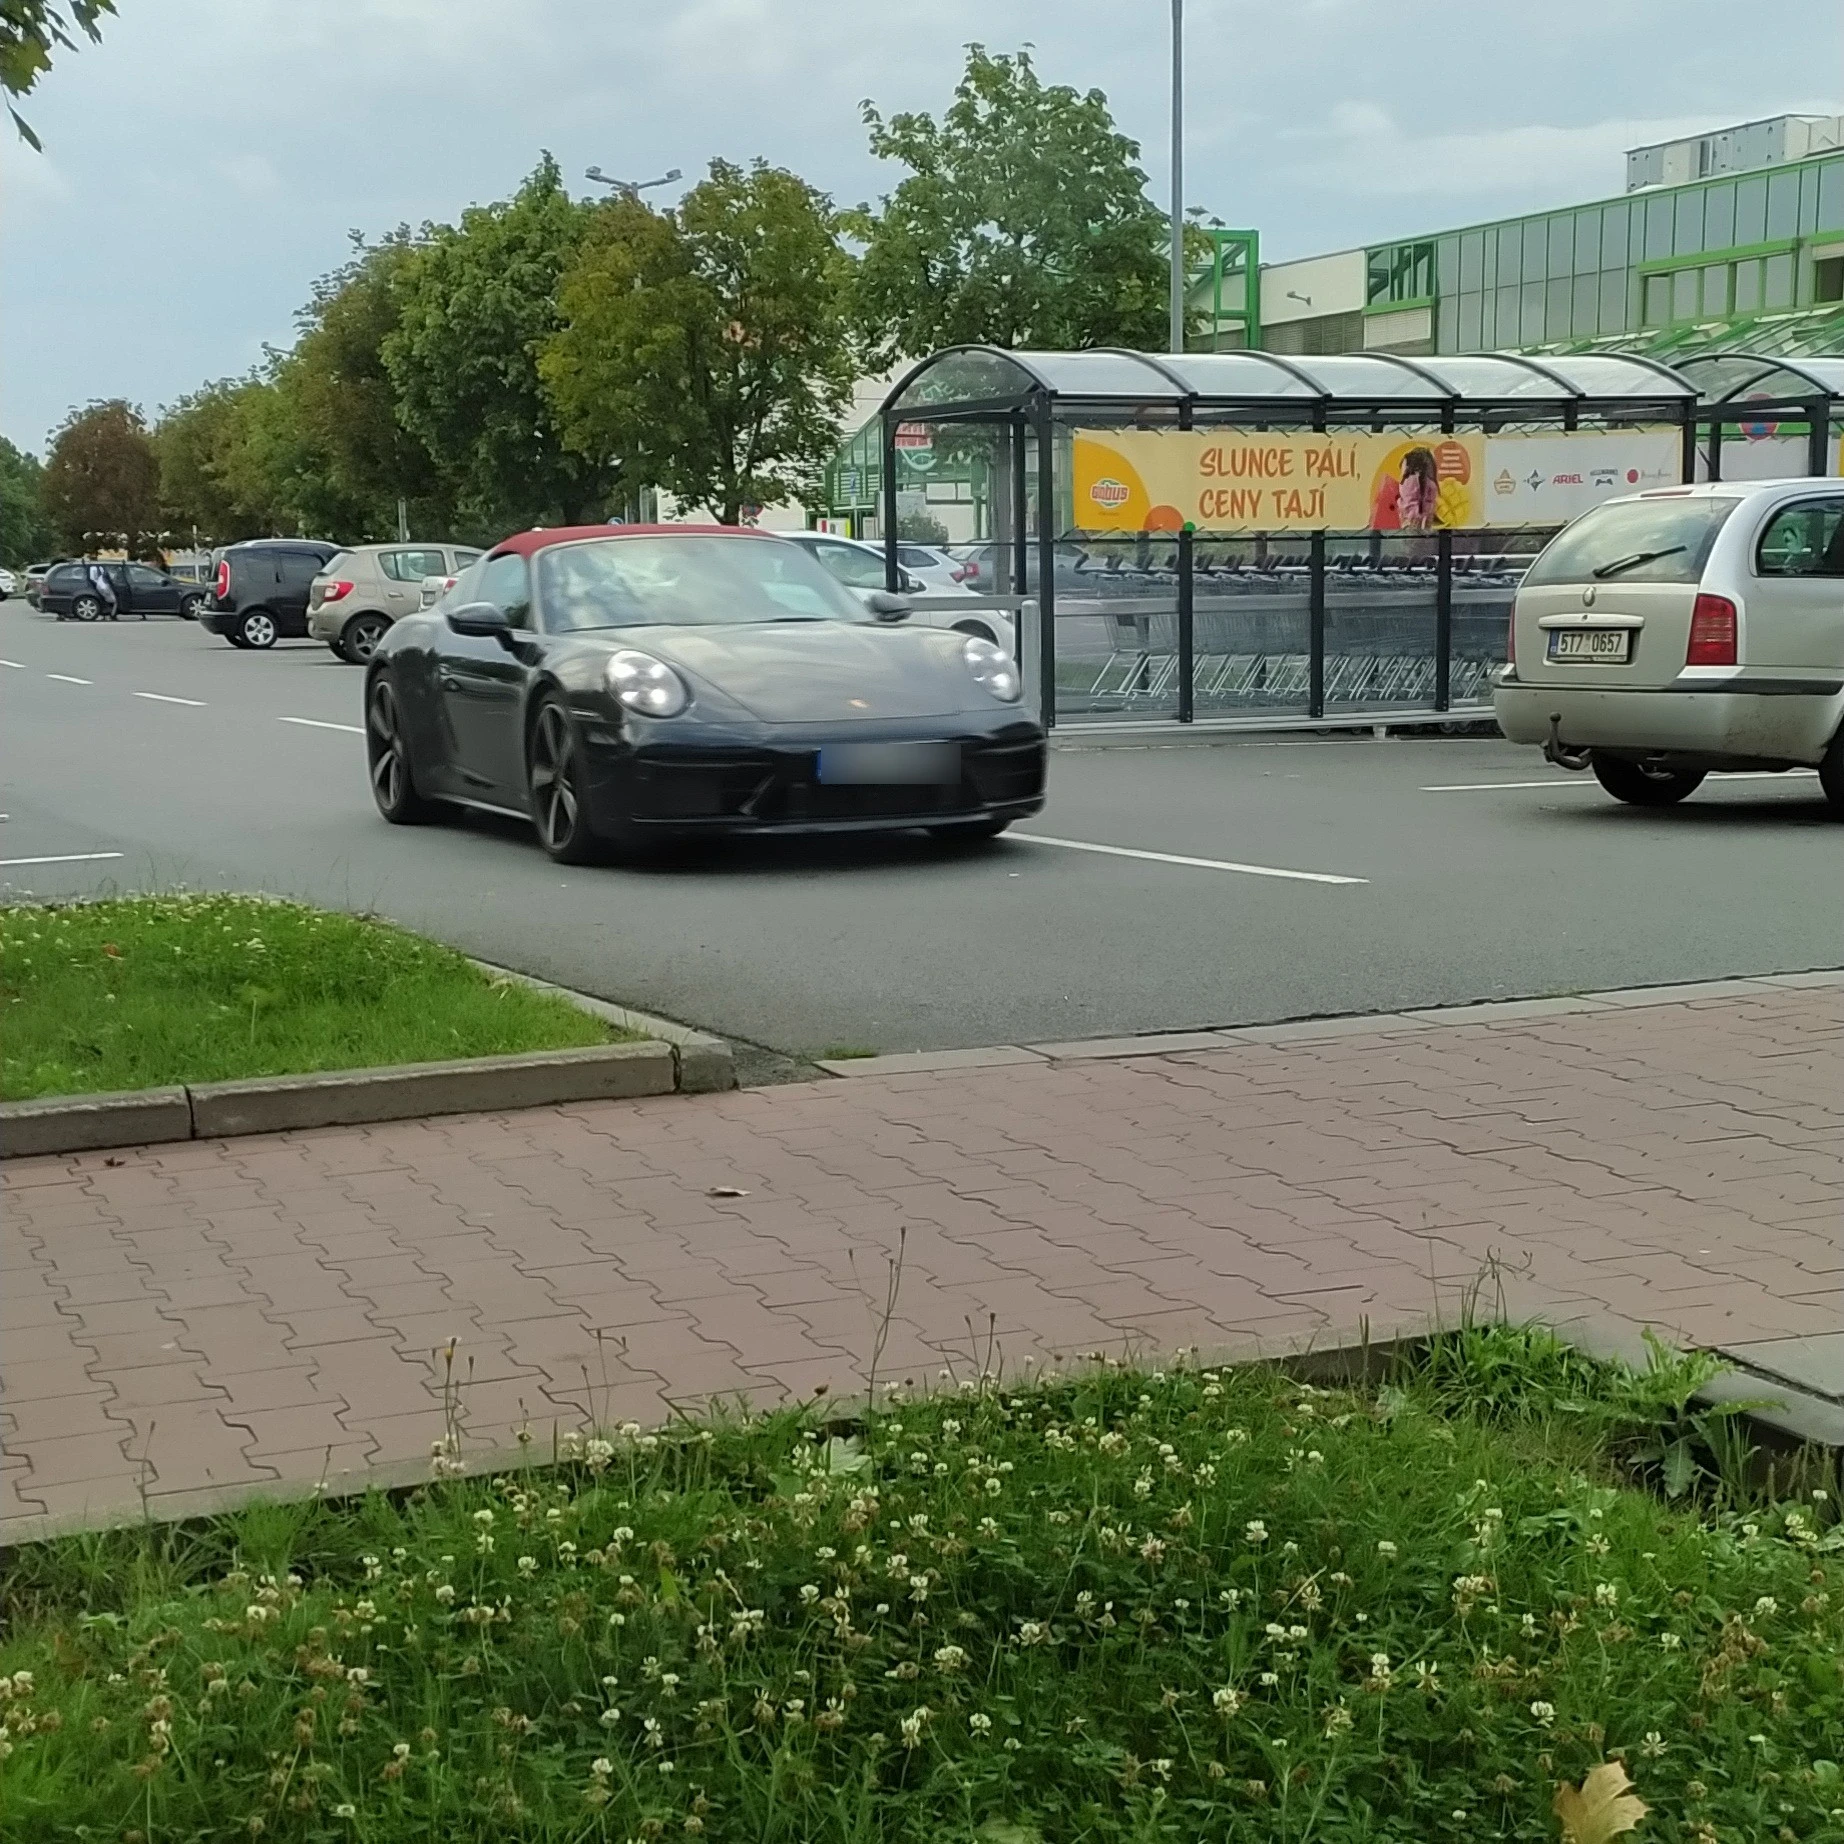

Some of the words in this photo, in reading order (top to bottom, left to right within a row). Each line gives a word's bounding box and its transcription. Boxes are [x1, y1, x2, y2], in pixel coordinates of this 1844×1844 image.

[1199, 447, 1294, 478] SLUNCE
[1305, 440, 1361, 481] PÁLÍ,
[1552, 473, 1583, 484] ARIEL
[1199, 488, 1262, 519] CENY
[1271, 483, 1328, 518] TAJÍ
[1560, 633, 1584, 653] 5T7
[1591, 633, 1622, 653] 0657
